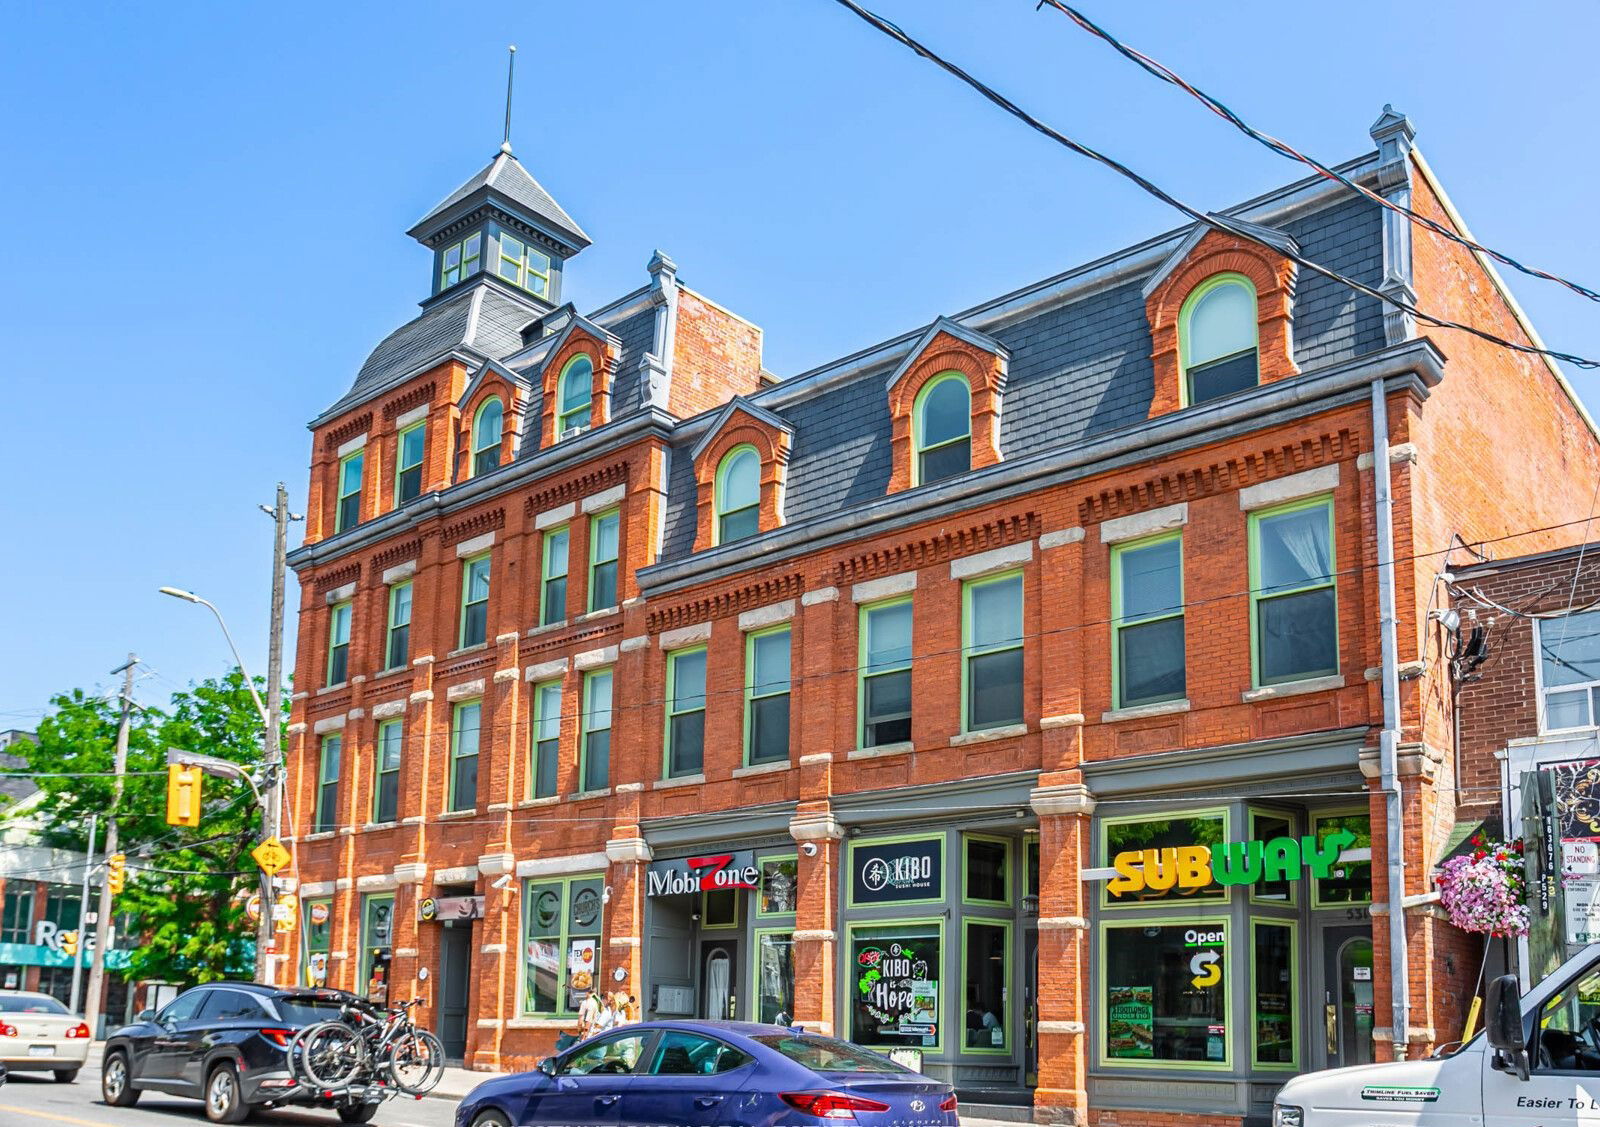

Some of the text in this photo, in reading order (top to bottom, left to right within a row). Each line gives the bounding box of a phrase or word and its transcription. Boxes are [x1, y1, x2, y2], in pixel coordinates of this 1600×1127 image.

[1574, 845, 1585, 853] NO
[895, 856, 931, 880] KIBO
[1106, 828, 1357, 897] SUBWAY
[35, 919, 116, 951] Real
[1185, 930, 1224, 946] Open
[882, 959, 910, 978] KIBO
[876, 983, 914, 1010] Hope
[1517, 1096, 1600, 1110] Easier To L
